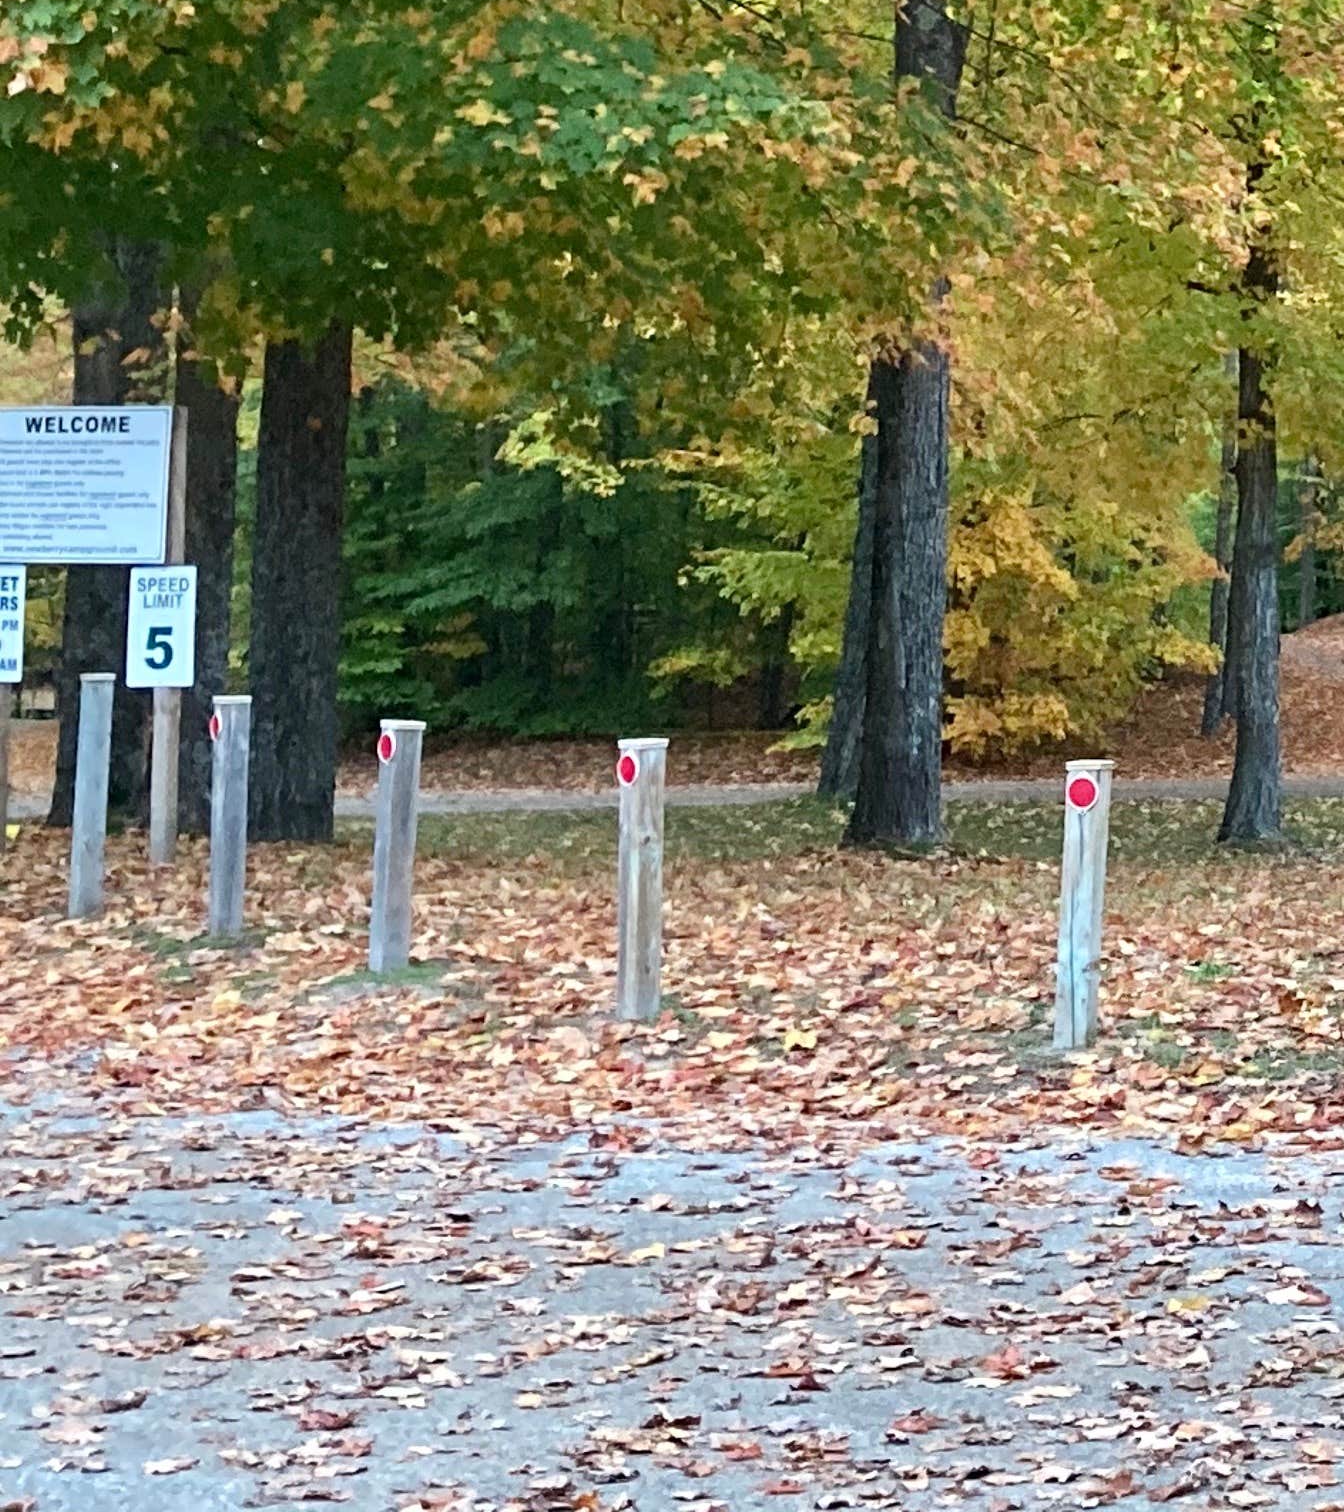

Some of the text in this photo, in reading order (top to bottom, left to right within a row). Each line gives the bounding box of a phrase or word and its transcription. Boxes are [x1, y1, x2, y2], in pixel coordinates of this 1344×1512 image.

[25, 416, 131, 433] WELCOME
[0, 576, 19, 592] ET
[137, 577, 190, 592] SPEED
[0, 596, 18, 610] RS
[143, 594, 184, 609] LIMIT
[2, 619, 19, 631] PM
[144, 626, 173, 669] 5
